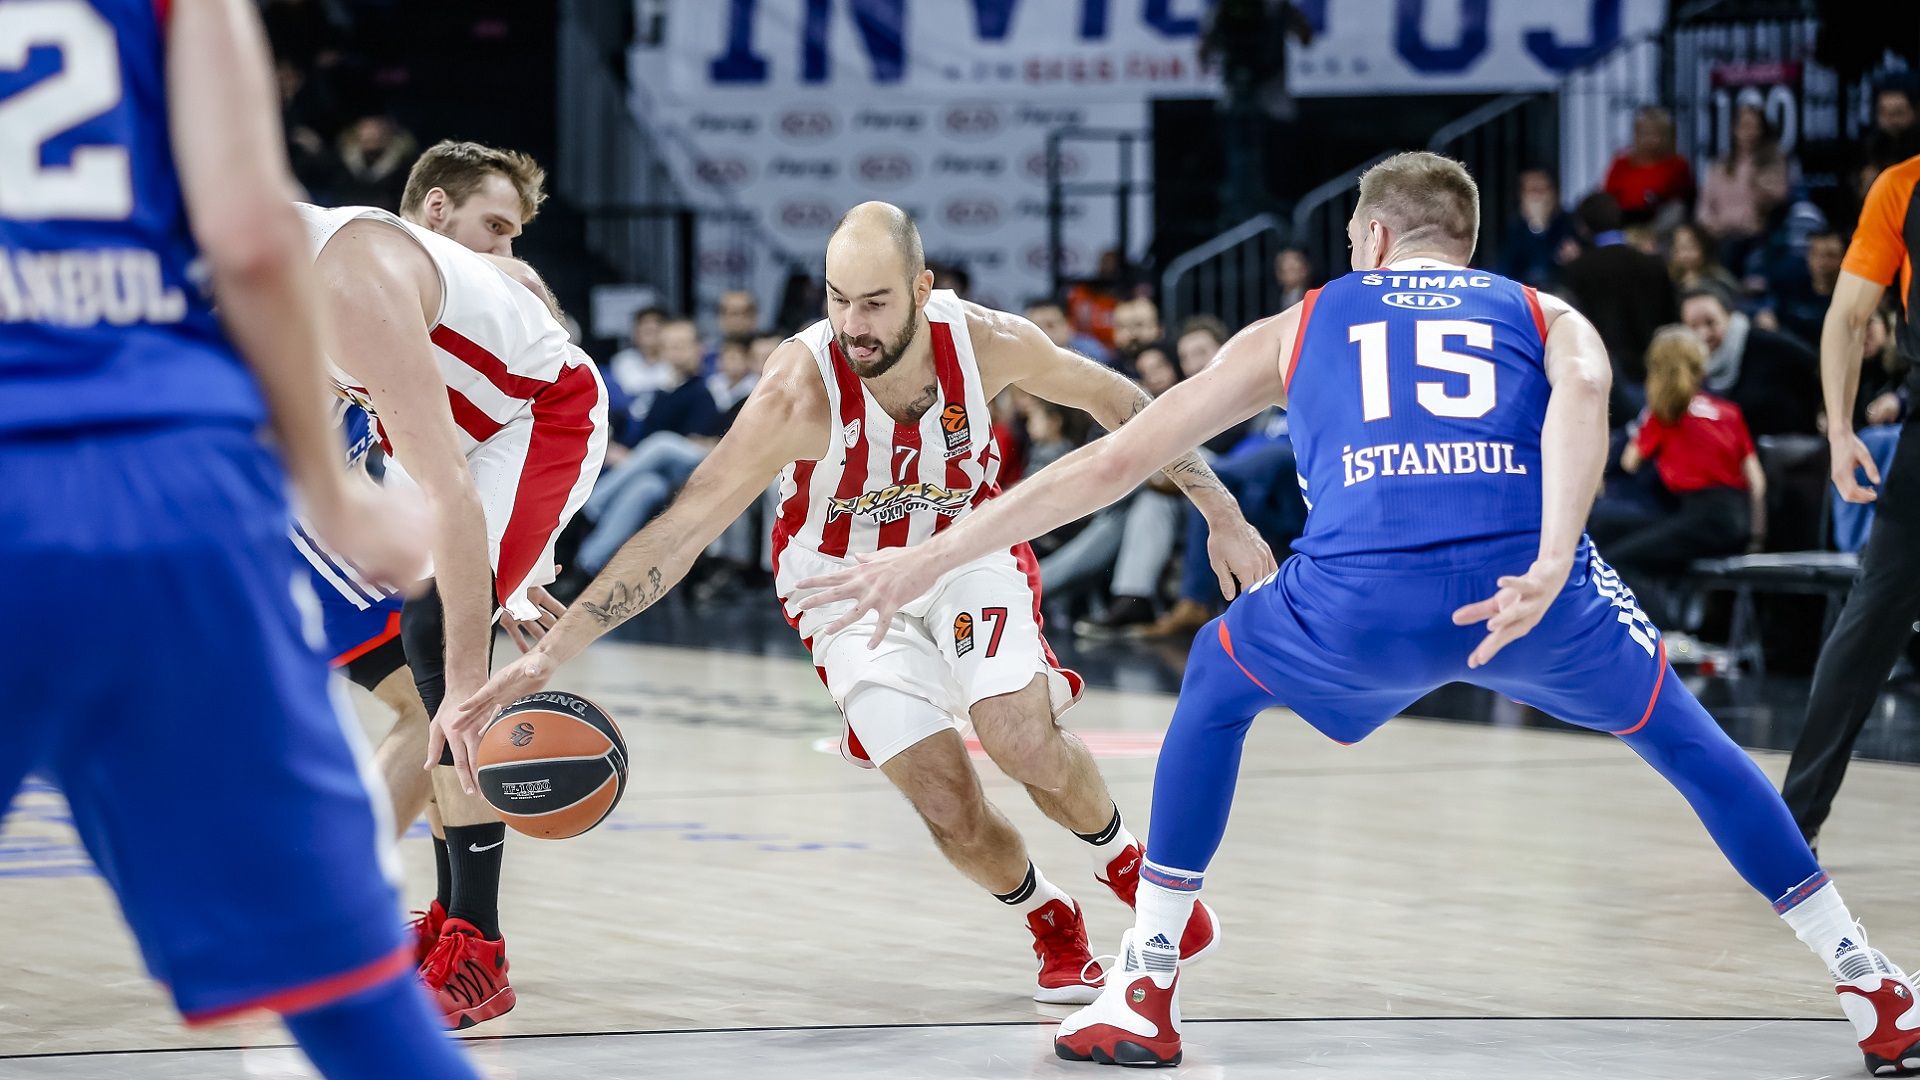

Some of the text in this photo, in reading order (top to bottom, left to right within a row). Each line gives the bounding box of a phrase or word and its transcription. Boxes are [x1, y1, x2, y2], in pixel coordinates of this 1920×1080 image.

[1361, 273, 1492, 289] ŠTIMAC
[1394, 293, 1449, 307] KIA
[1348, 319, 1497, 423] 15
[896, 446, 918, 481] 7
[1341, 441, 1527, 487] İSTANBUL
[982, 607, 1008, 658] 7
[498, 693, 588, 717] LDING
[1145, 941, 1175, 951] adidas
